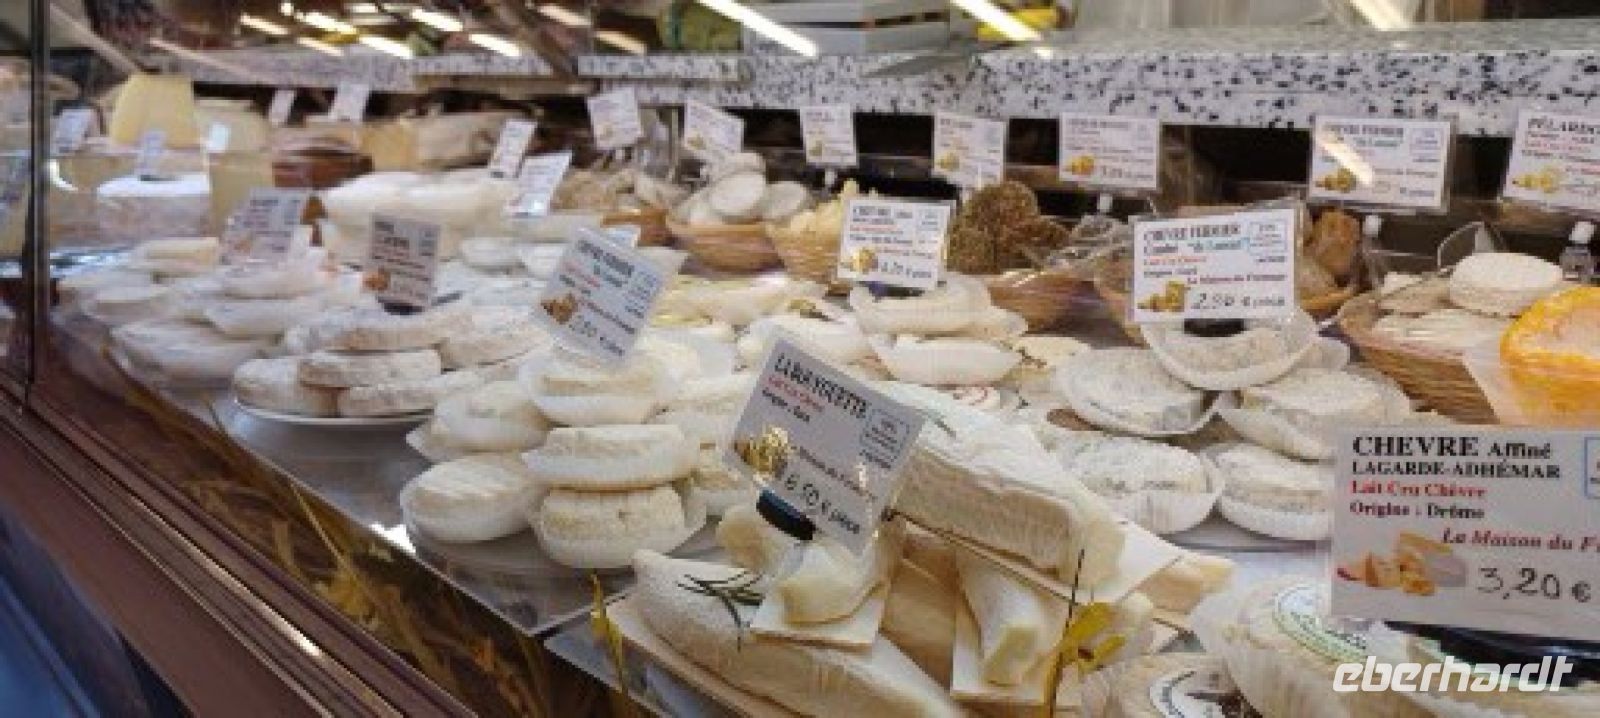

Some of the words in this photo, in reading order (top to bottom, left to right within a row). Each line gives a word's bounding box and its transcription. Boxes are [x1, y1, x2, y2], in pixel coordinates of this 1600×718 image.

[1189, 224, 1241, 238] FERMIER
[1352, 436, 1479, 457] CHEVRE
[1487, 442, 1552, 460] Affiné
[1352, 458, 1561, 479] LAGARDE-ADHÉMAR
[1351, 480, 1384, 495] Lait
[1387, 480, 1420, 497] Cru
[1424, 482, 1487, 498] Chèvre
[1349, 501, 1411, 519] Origine
[1427, 502, 1486, 519] Drôme
[1442, 527, 1467, 544] La
[1471, 530, 1542, 548] Maison
[1549, 534, 1573, 551] du
[1477, 566, 1561, 600] 3,20
[1571, 581, 1592, 603] €
